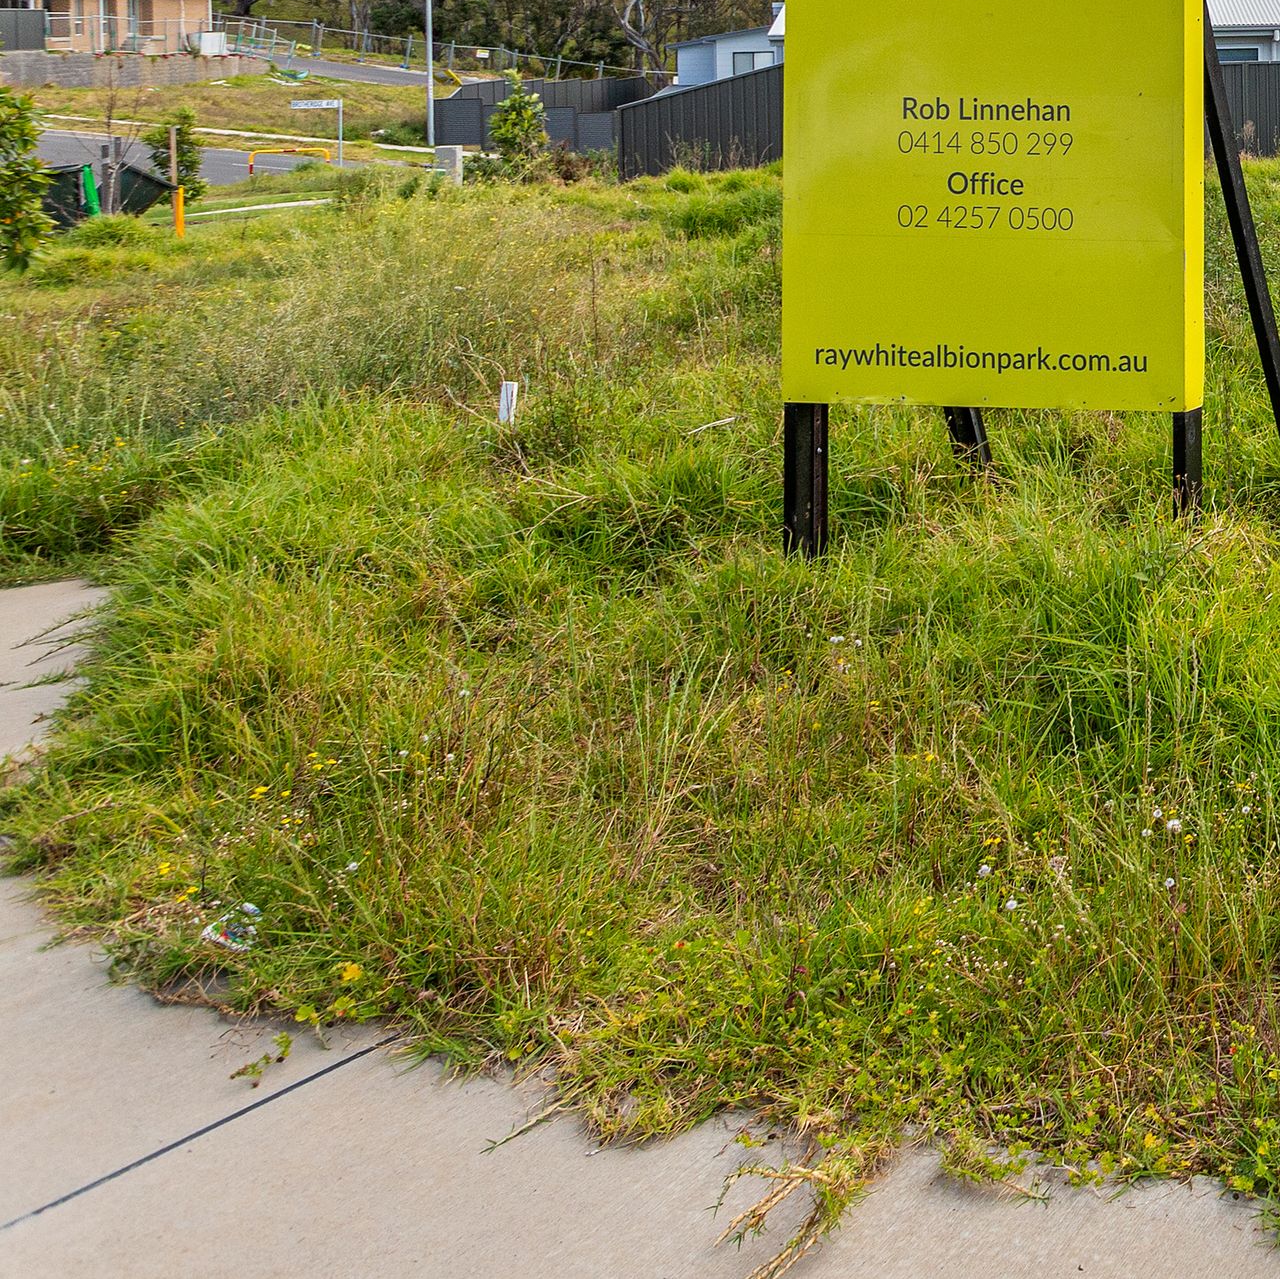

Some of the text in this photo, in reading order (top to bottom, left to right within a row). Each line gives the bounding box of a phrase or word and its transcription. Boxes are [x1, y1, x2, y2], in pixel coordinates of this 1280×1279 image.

[902, 96, 1071, 122] Rob Linnehan
[897, 130, 1074, 156] 0414 850 299
[947, 171, 1025, 196] Office
[897, 204, 1074, 231] 02 4257 0500
[814, 342, 1148, 374] raywhitealbionpark.com.au
